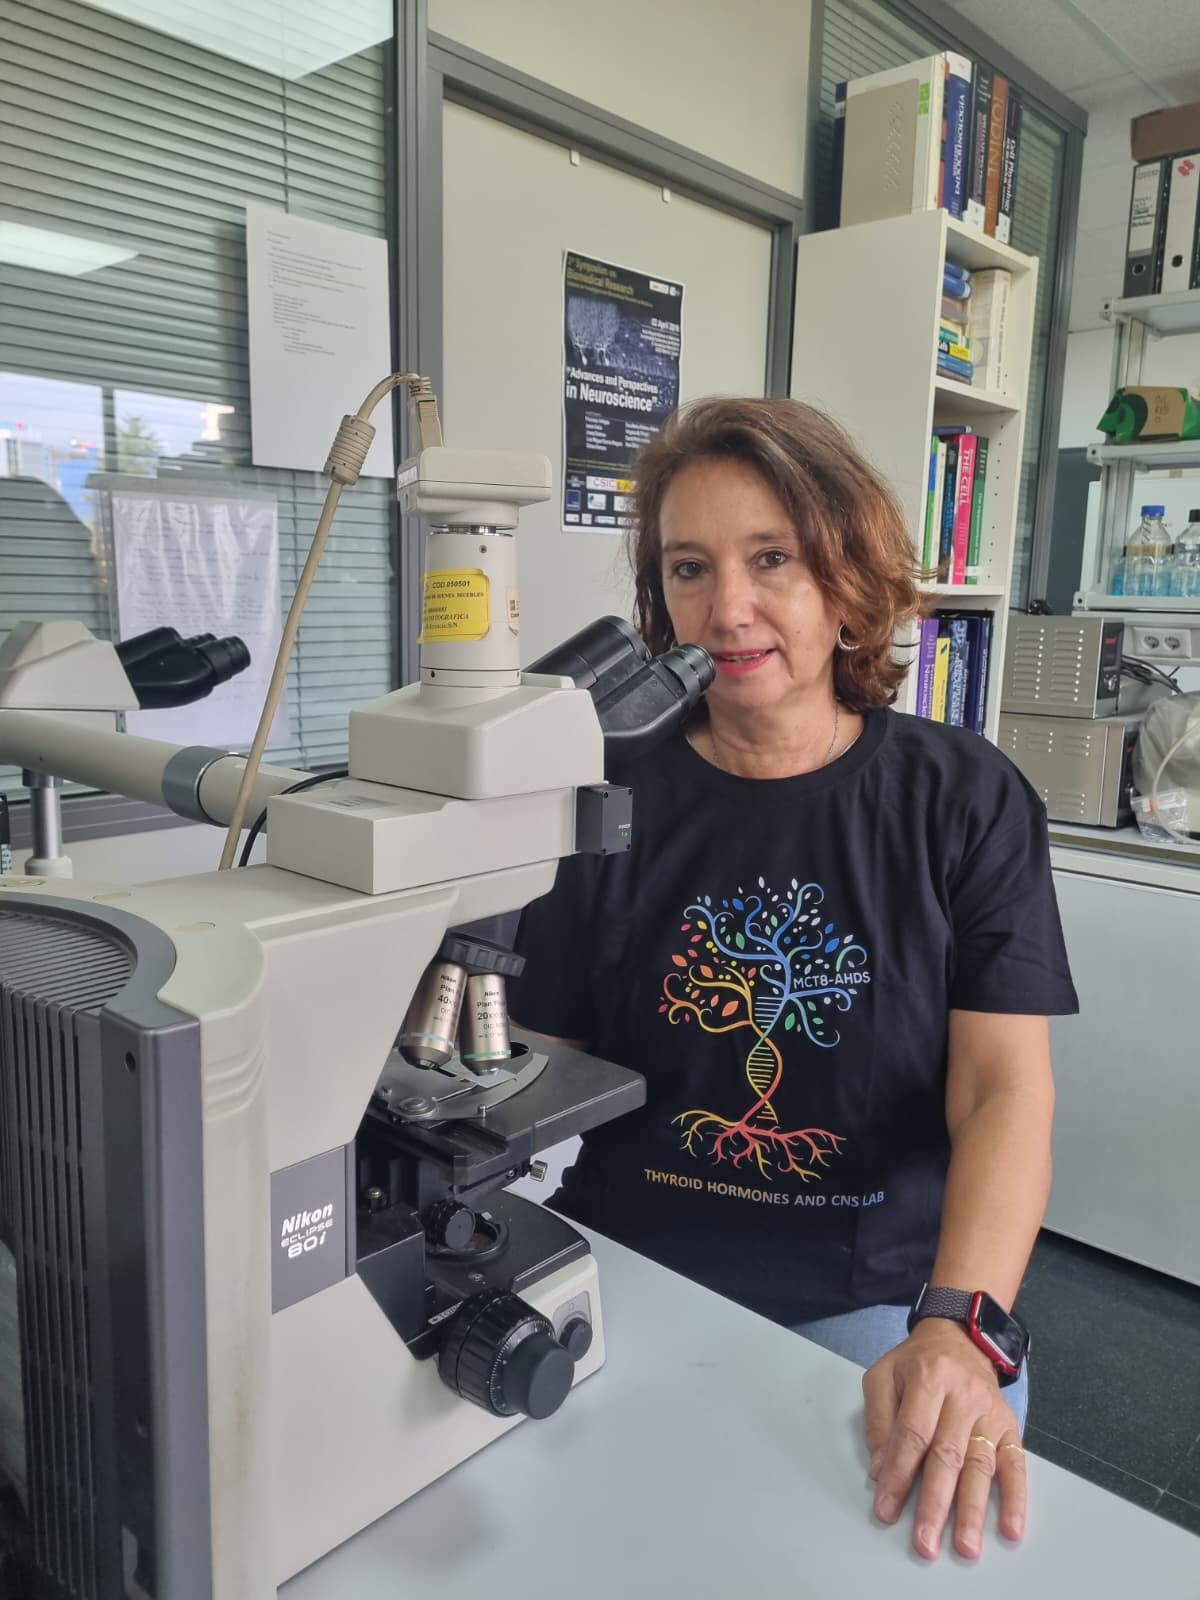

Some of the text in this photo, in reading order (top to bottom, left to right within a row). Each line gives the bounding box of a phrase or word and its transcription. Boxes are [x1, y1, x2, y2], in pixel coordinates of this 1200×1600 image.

[566, 381, 577, 399] in
[605, 375, 618, 386] and
[618, 376, 658, 394] Perspectives
[962, 449, 971, 473] THE
[959, 475, 970, 506] CELL
[793, 971, 871, 989] MCT8-AHDS
[643, 1168, 885, 1208] THYROID HORMONES AND CNS LAB
[281, 1203, 334, 1237] Nikon
